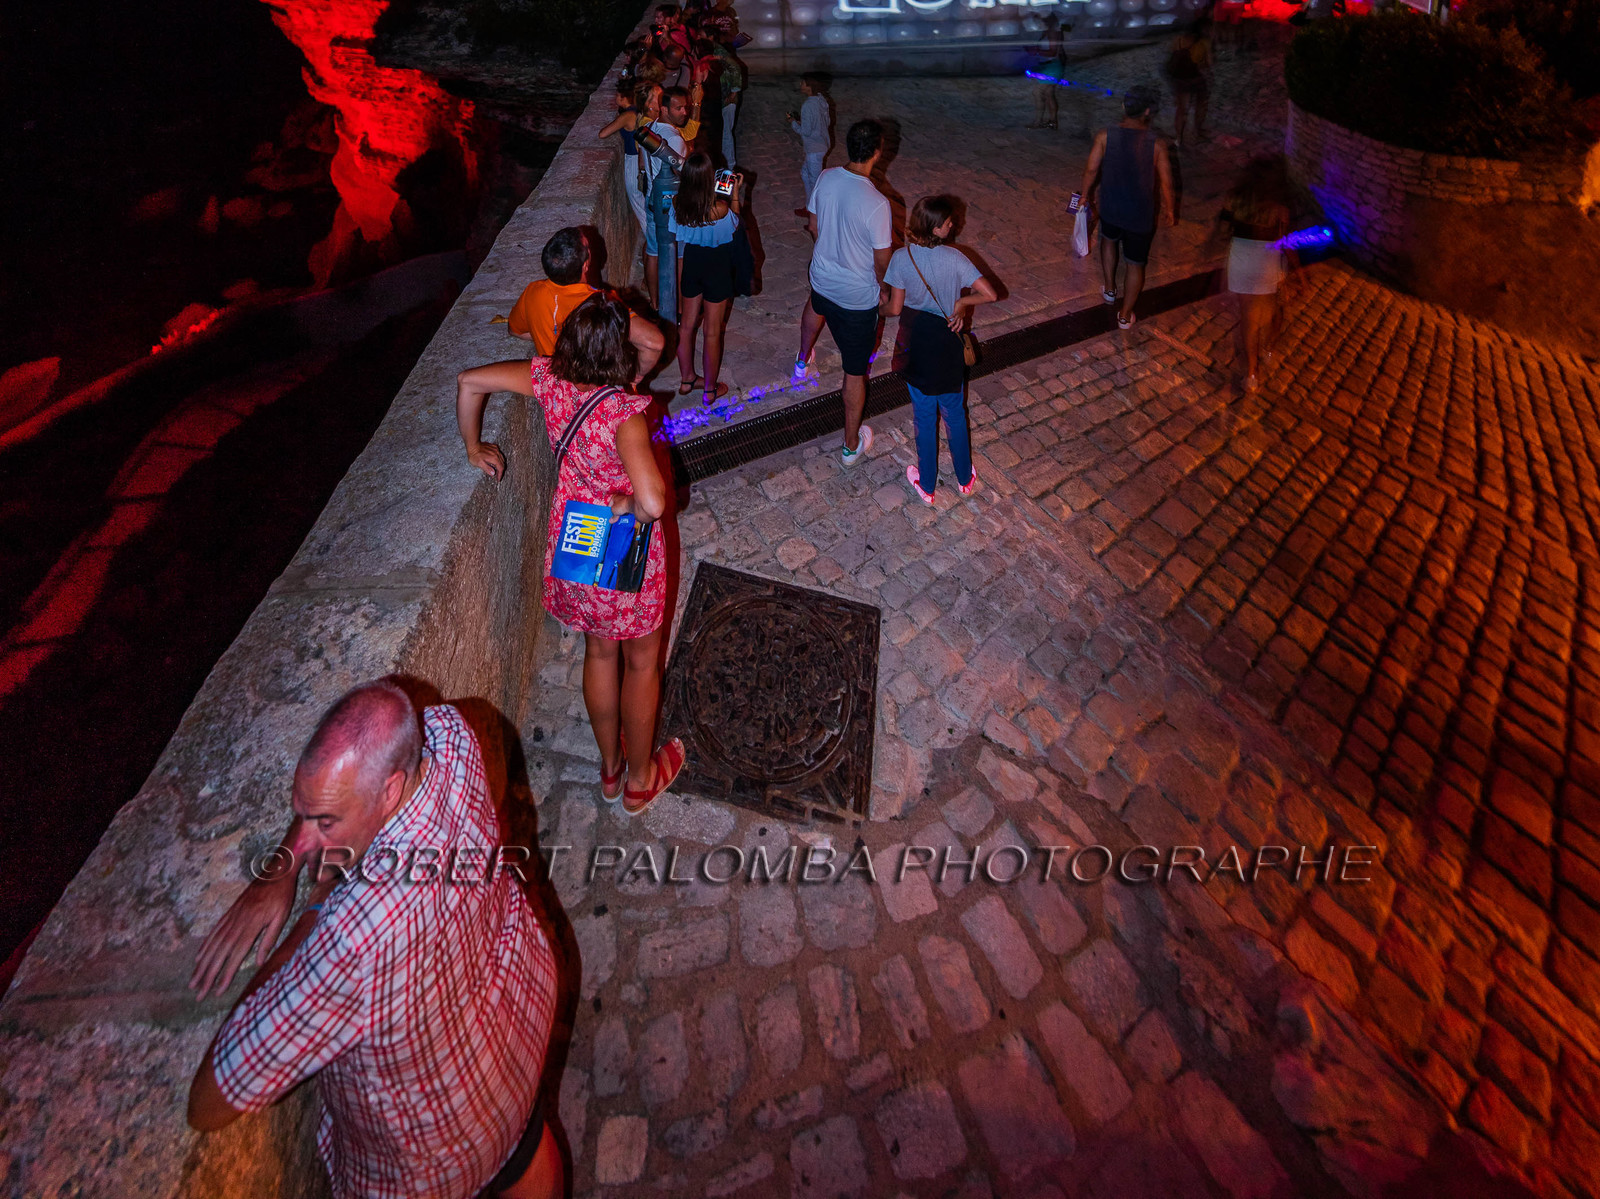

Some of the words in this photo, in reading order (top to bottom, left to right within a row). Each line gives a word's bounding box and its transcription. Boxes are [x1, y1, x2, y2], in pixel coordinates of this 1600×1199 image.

[561, 511, 584, 554] FESTI
[574, 515, 599, 556] LUMI
[589, 517, 604, 557] BONIFACIO
